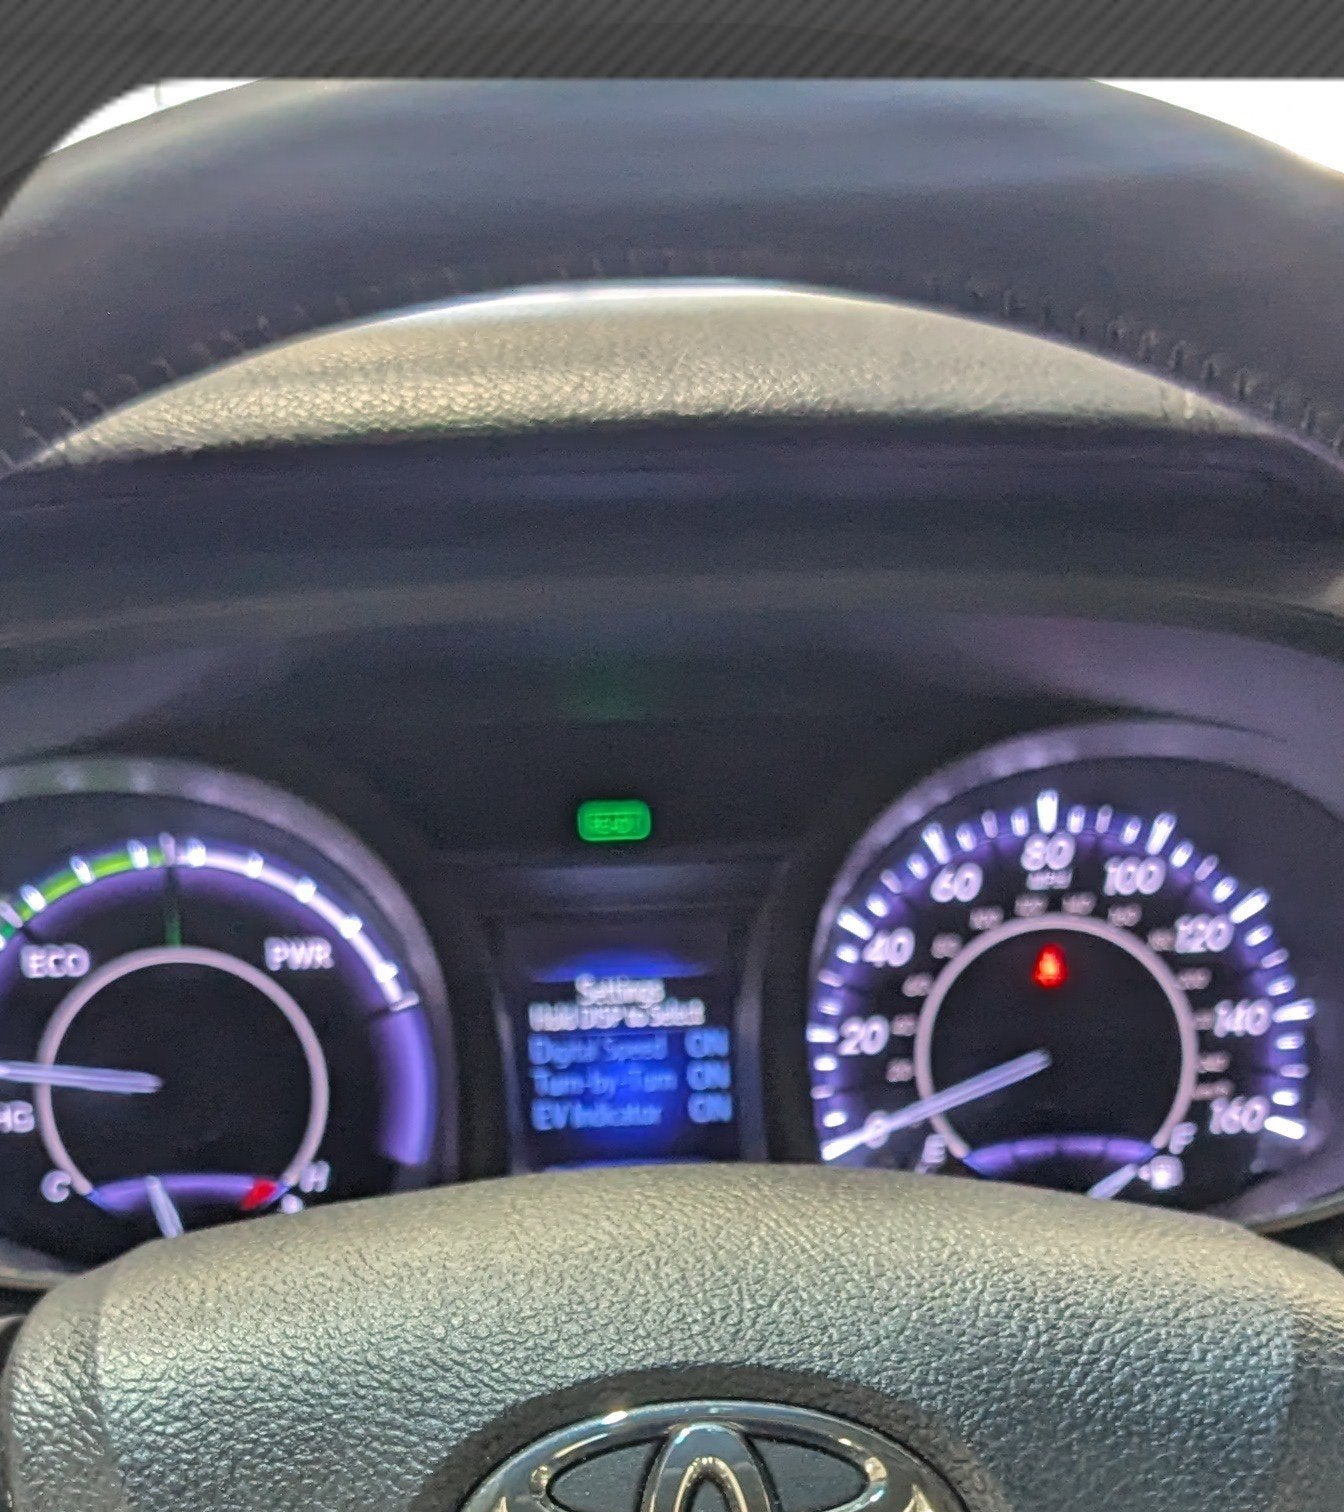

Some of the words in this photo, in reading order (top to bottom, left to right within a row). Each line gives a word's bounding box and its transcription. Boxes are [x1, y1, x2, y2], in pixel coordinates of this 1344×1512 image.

[1022, 833, 1075, 872] 80
[930, 862, 983, 903] 60
[1104, 856, 1166, 896] 100
[863, 927, 915, 968] 40
[1174, 914, 1234, 954] 120
[20, 944, 89, 978] ECO
[264, 937, 334, 971] PWR
[837, 1016, 890, 1056] 20
[1213, 999, 1272, 1038] 140
[685, 1027, 730, 1058] ON
[687, 1060, 731, 1091] ON
[688, 1092, 733, 1123] ON
[1209, 1096, 1271, 1135] 160
[40, 1170, 72, 1203] C
[299, 1160, 331, 1192] H
